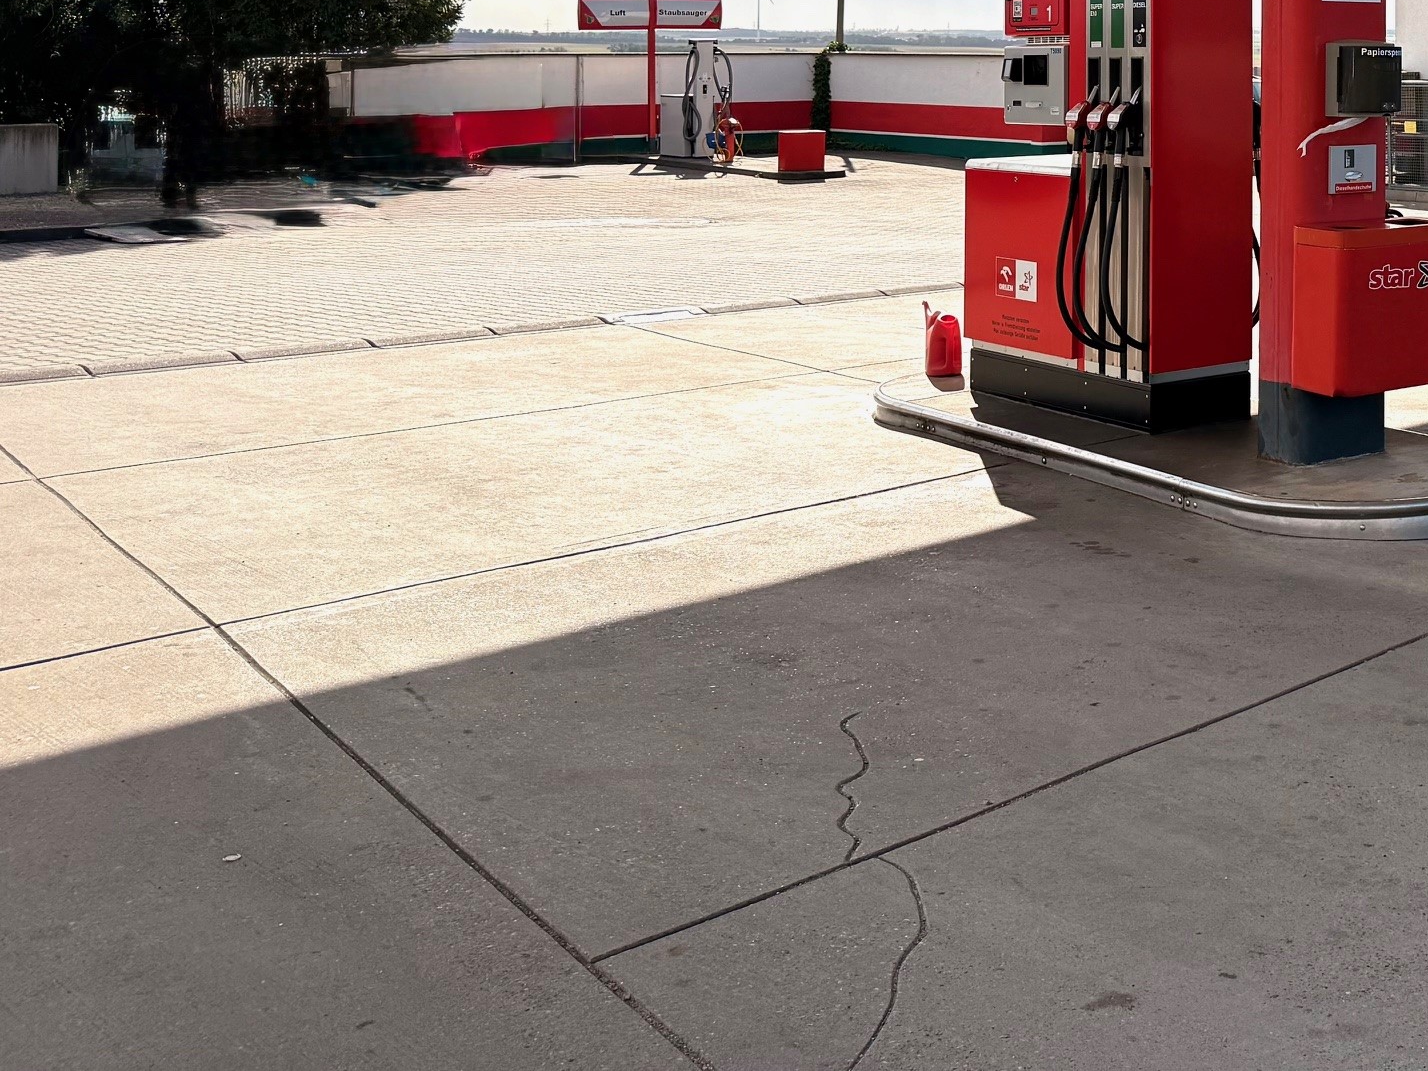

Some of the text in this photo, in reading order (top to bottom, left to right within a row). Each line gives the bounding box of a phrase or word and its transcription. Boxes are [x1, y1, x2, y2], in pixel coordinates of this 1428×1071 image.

[658, 9, 708, 17] Staubsauger
[1046, 5, 1052, 22] 1
[1368, 264, 1415, 290] star
